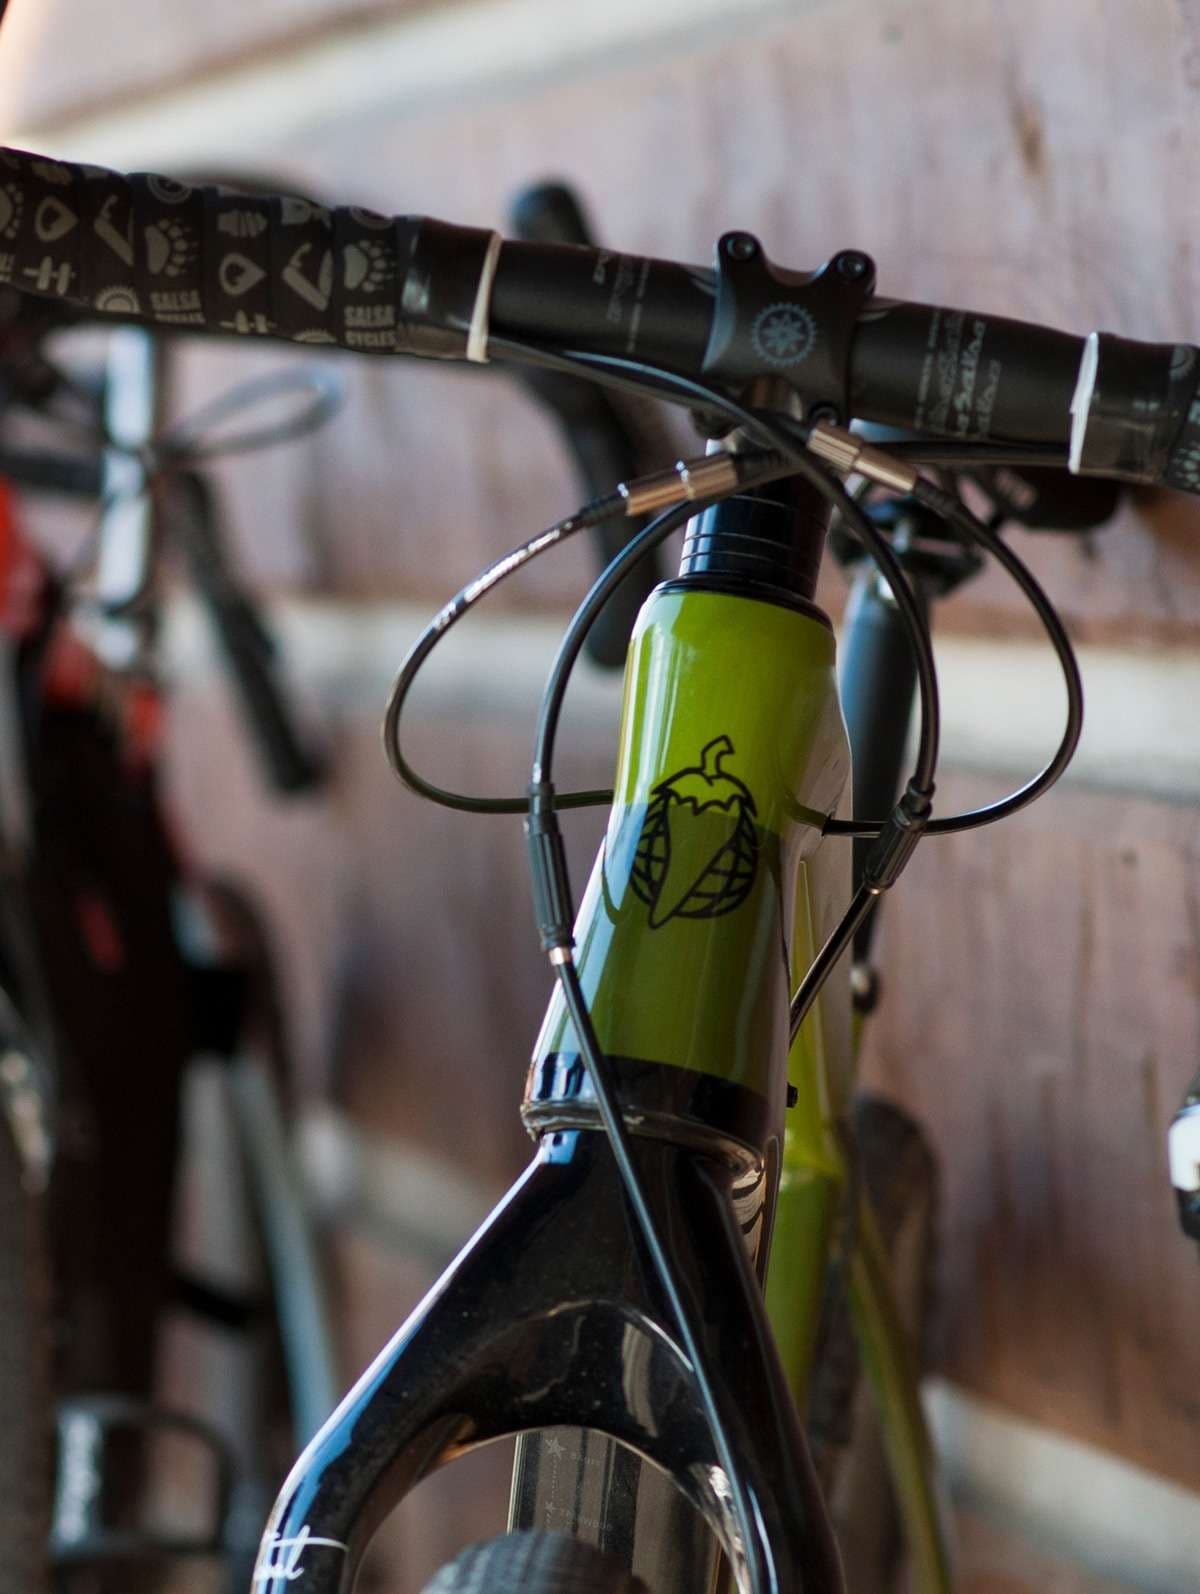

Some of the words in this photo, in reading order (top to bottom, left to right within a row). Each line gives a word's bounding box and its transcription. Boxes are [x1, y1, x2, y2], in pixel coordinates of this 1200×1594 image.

[150, 289, 203, 311] SALSA
[344, 304, 395, 327] SALSA
[345, 330, 397, 347] CYCLES
